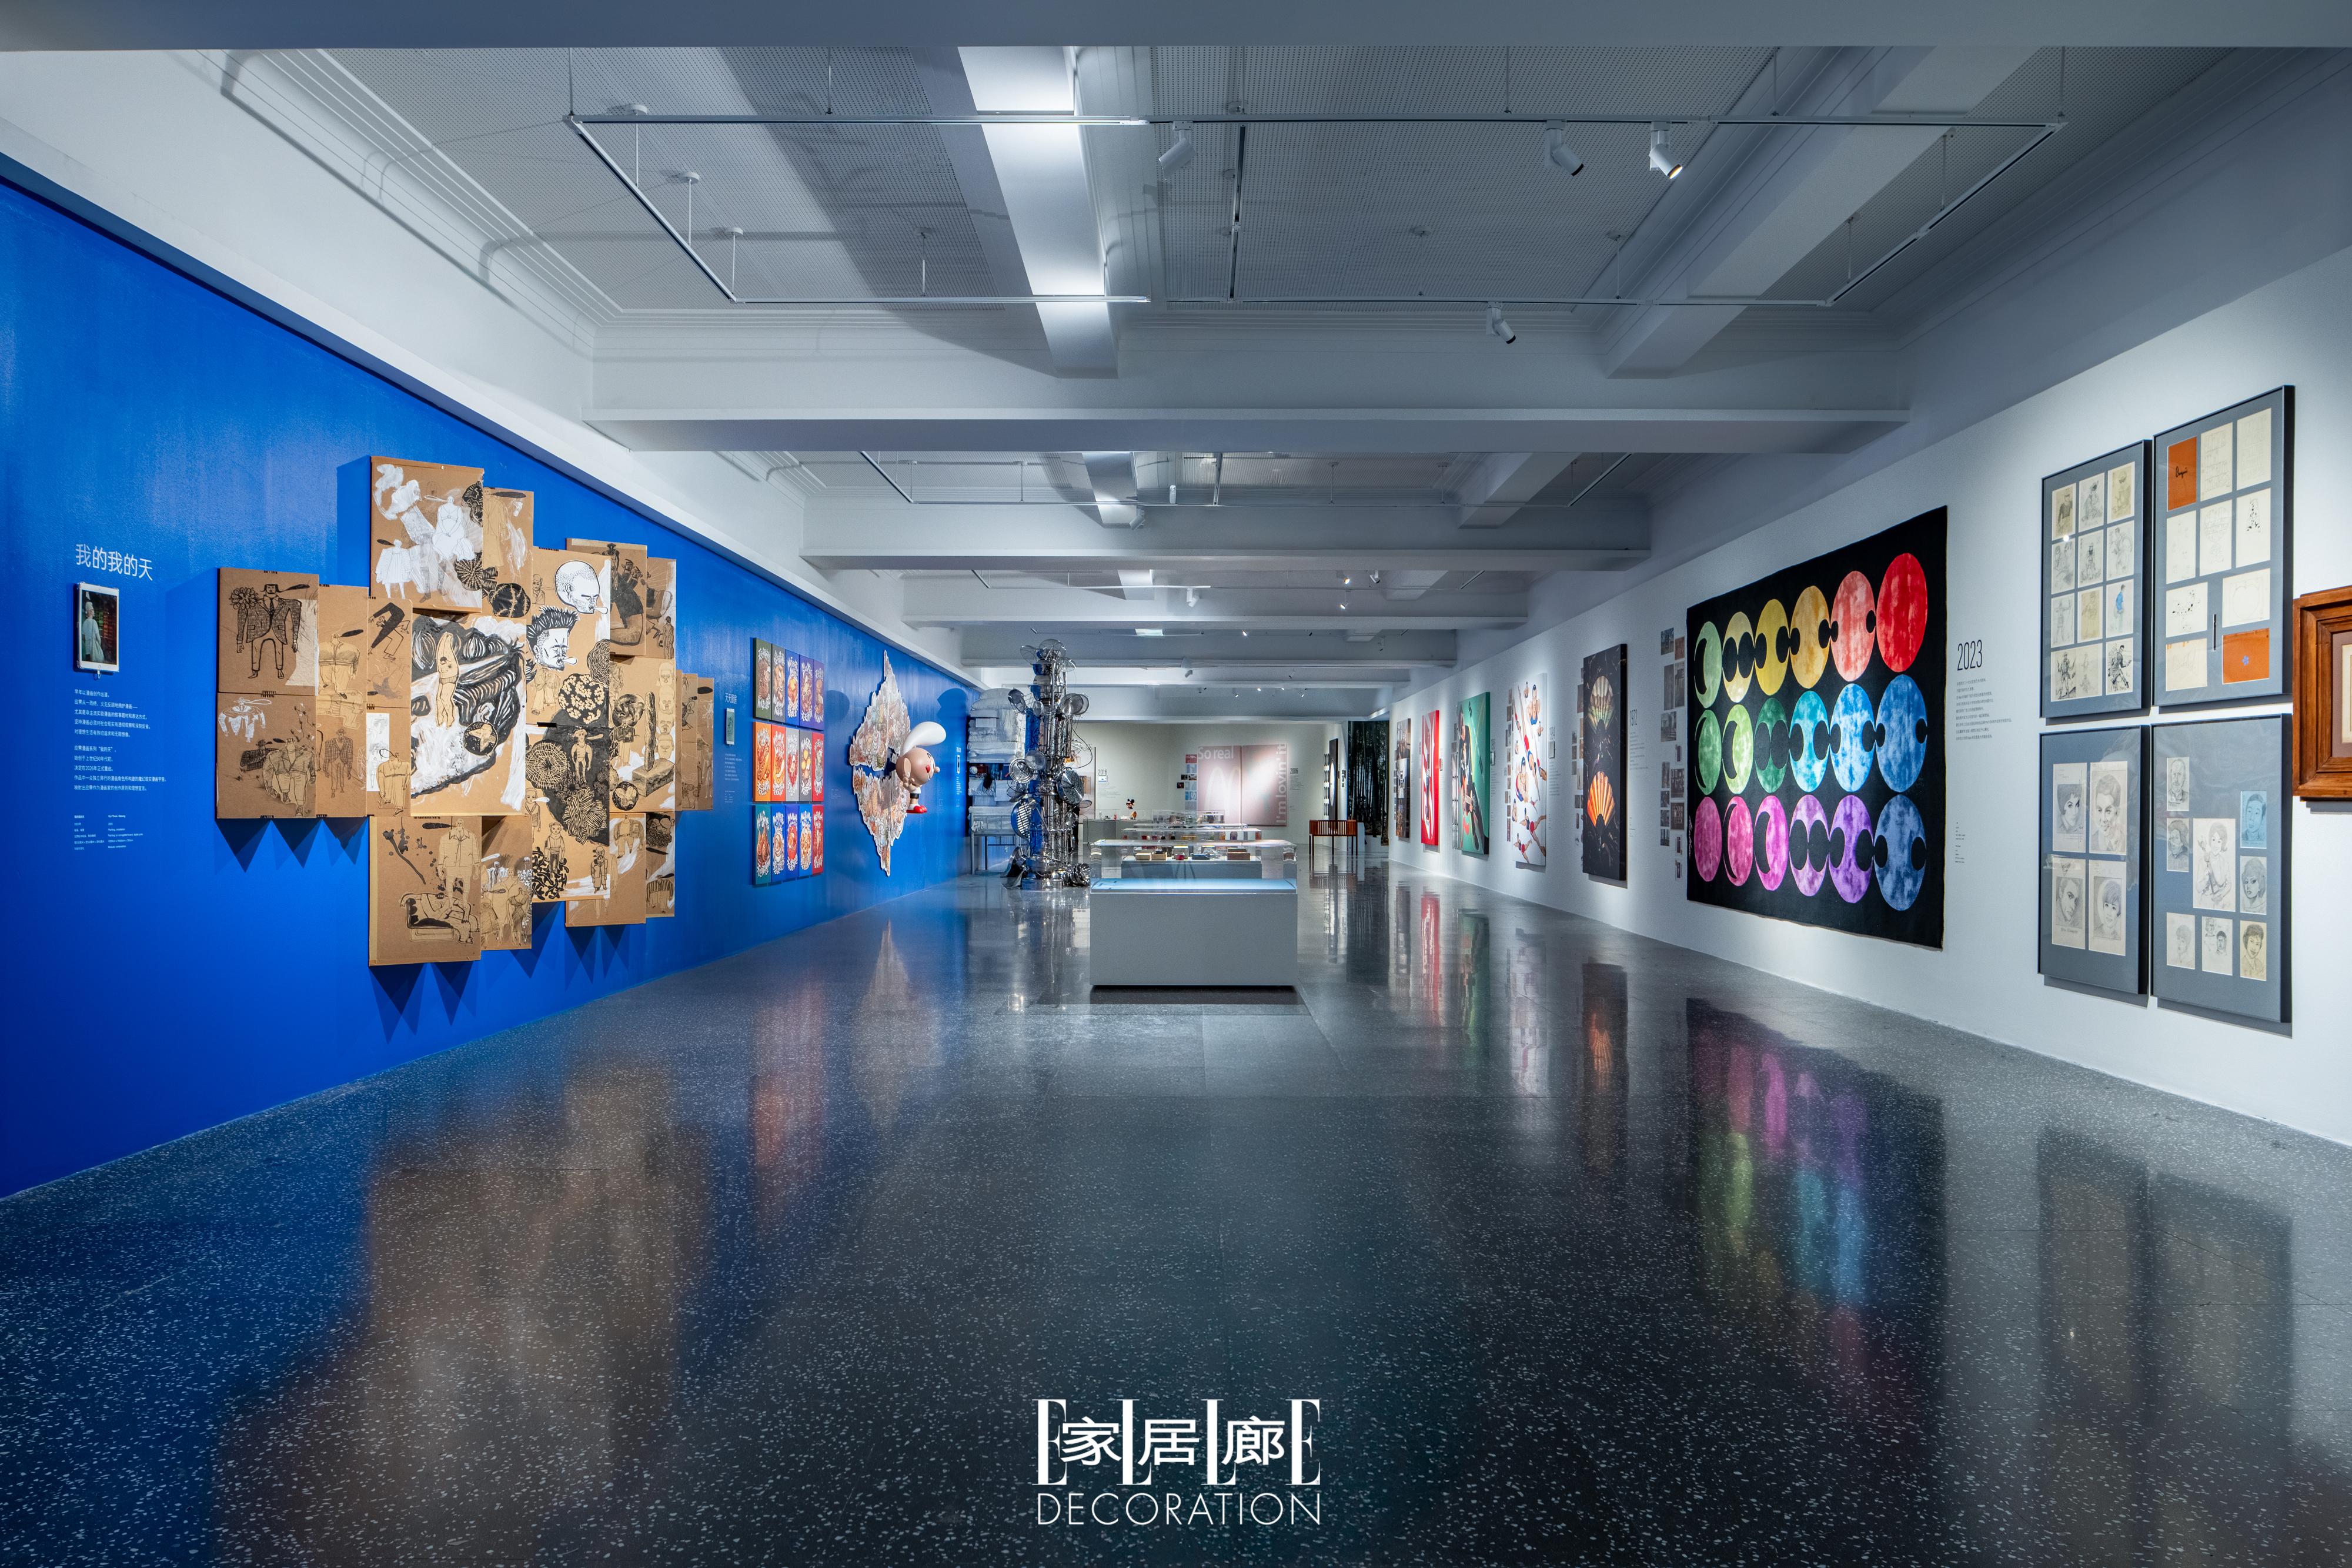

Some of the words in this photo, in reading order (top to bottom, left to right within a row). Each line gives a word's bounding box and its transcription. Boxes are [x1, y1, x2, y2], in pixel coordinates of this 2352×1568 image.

[75, 543, 153, 581] 我的我的天
[1957, 639, 1983, 671] 2023
[1198, 747, 1211, 760] So
[1214, 745, 1234, 760] real
[1276, 744, 1287, 754] it
[1276, 801, 1287, 823] I'm
